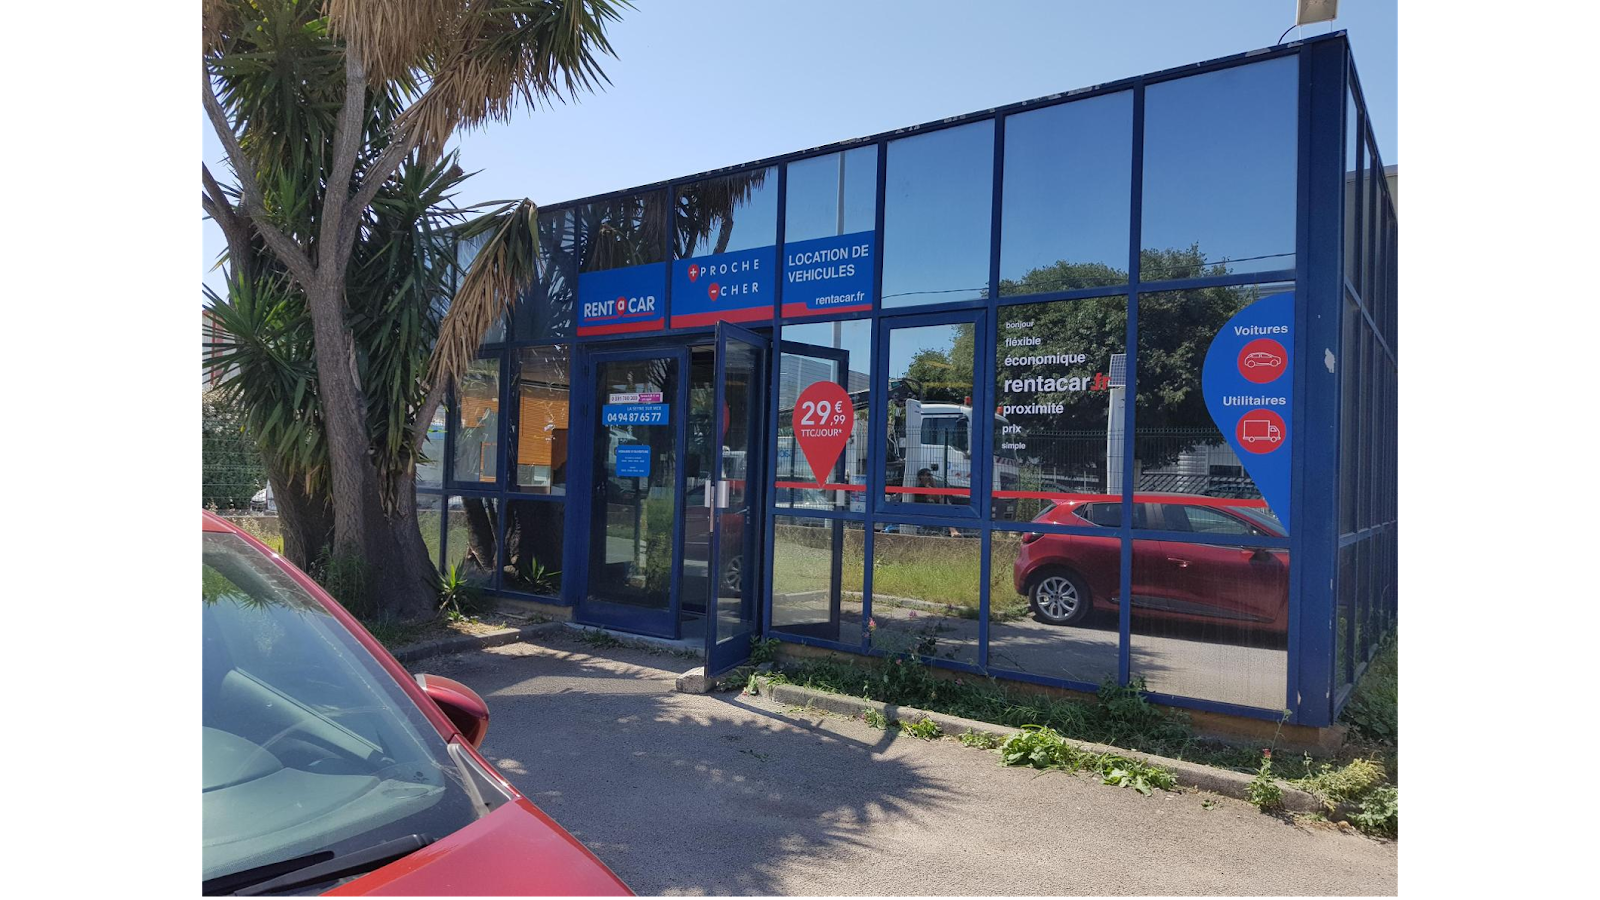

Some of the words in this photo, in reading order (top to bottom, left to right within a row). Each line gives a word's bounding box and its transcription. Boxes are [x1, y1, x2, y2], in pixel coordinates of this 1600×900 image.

[788, 247, 849, 267] LOCATION
[851, 244, 869, 259] DE
[700, 259, 760, 277] PROCHE
[788, 264, 855, 283] VEHICULES
[720, 282, 759, 297] CHER
[815, 291, 865, 305] rentacar.fr
[584, 300, 615, 318] RENT
[628, 296, 656, 314] CAR
[1005, 320, 1035, 330] bonjour
[1234, 325, 1289, 336] Voitures
[1005, 336, 1042, 347] fléxible
[1004, 352, 1086, 367] économique
[1004, 372, 1112, 393] rentacar.fr
[1223, 395, 1287, 407] Utilitaires
[607, 413, 617, 422] 04
[618, 413, 628, 422] 94
[629, 413, 639, 422] 87
[640, 413, 650, 422] 65
[651, 412, 662, 422] 77
[801, 400, 831, 425] 29
[834, 401, 843, 413] €
[1003, 402, 1064, 417] proximité
[1002, 424, 1022, 435] prix
[1001, 441, 1026, 450] simple
